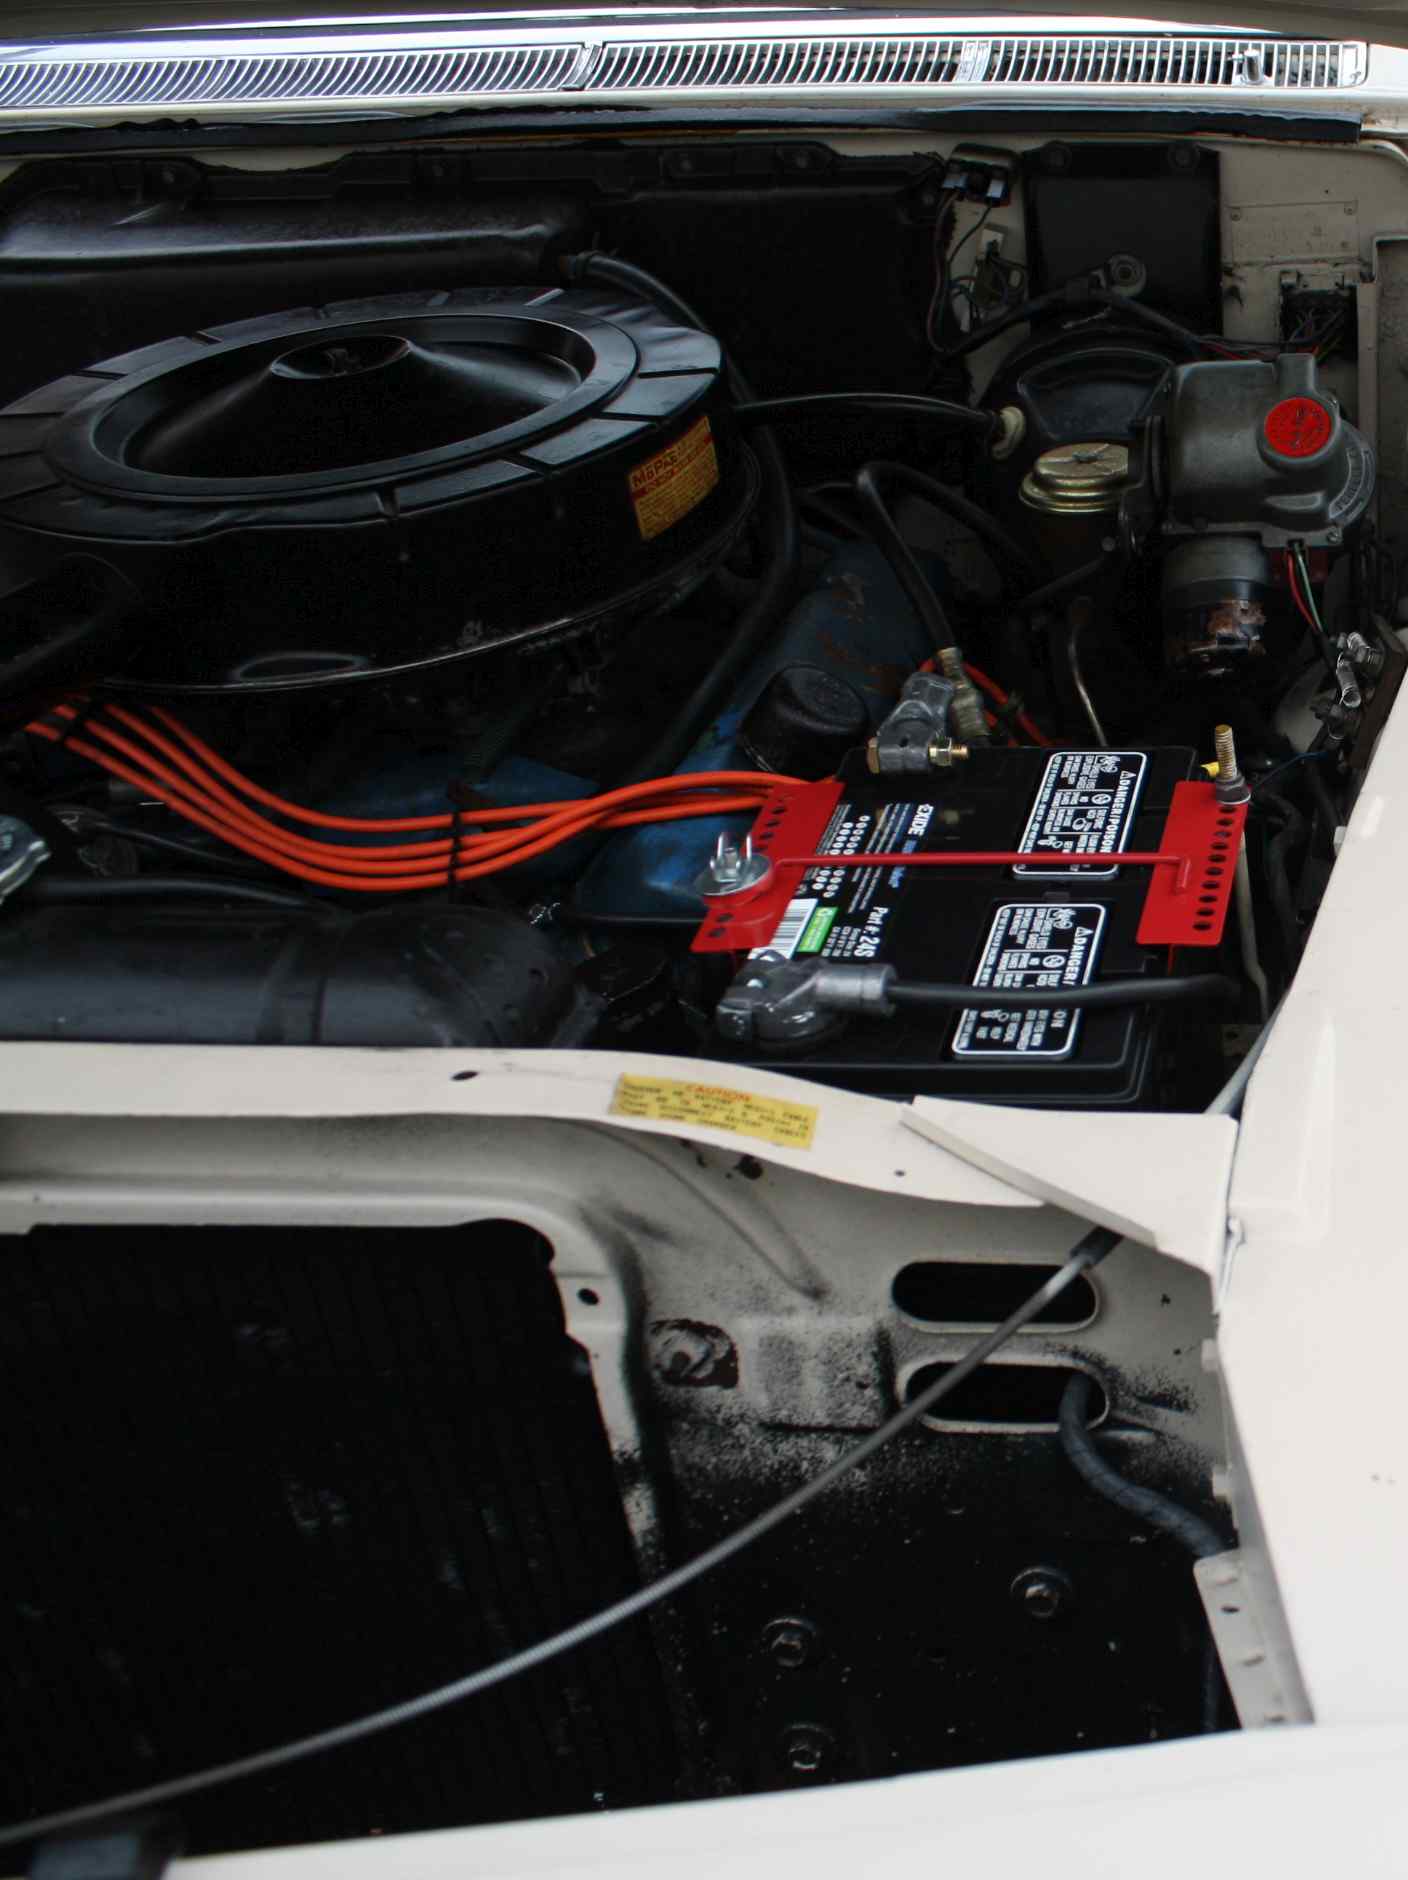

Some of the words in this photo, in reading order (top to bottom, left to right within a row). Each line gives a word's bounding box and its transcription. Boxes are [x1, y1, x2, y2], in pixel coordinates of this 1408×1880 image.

[908, 804, 934, 837] EXIDE
[1101, 779, 1131, 853] DANGER/POISON
[866, 907, 889, 925] Part
[853, 936, 880, 958] 24S
[1050, 936, 1087, 1028] DANGER/ON
